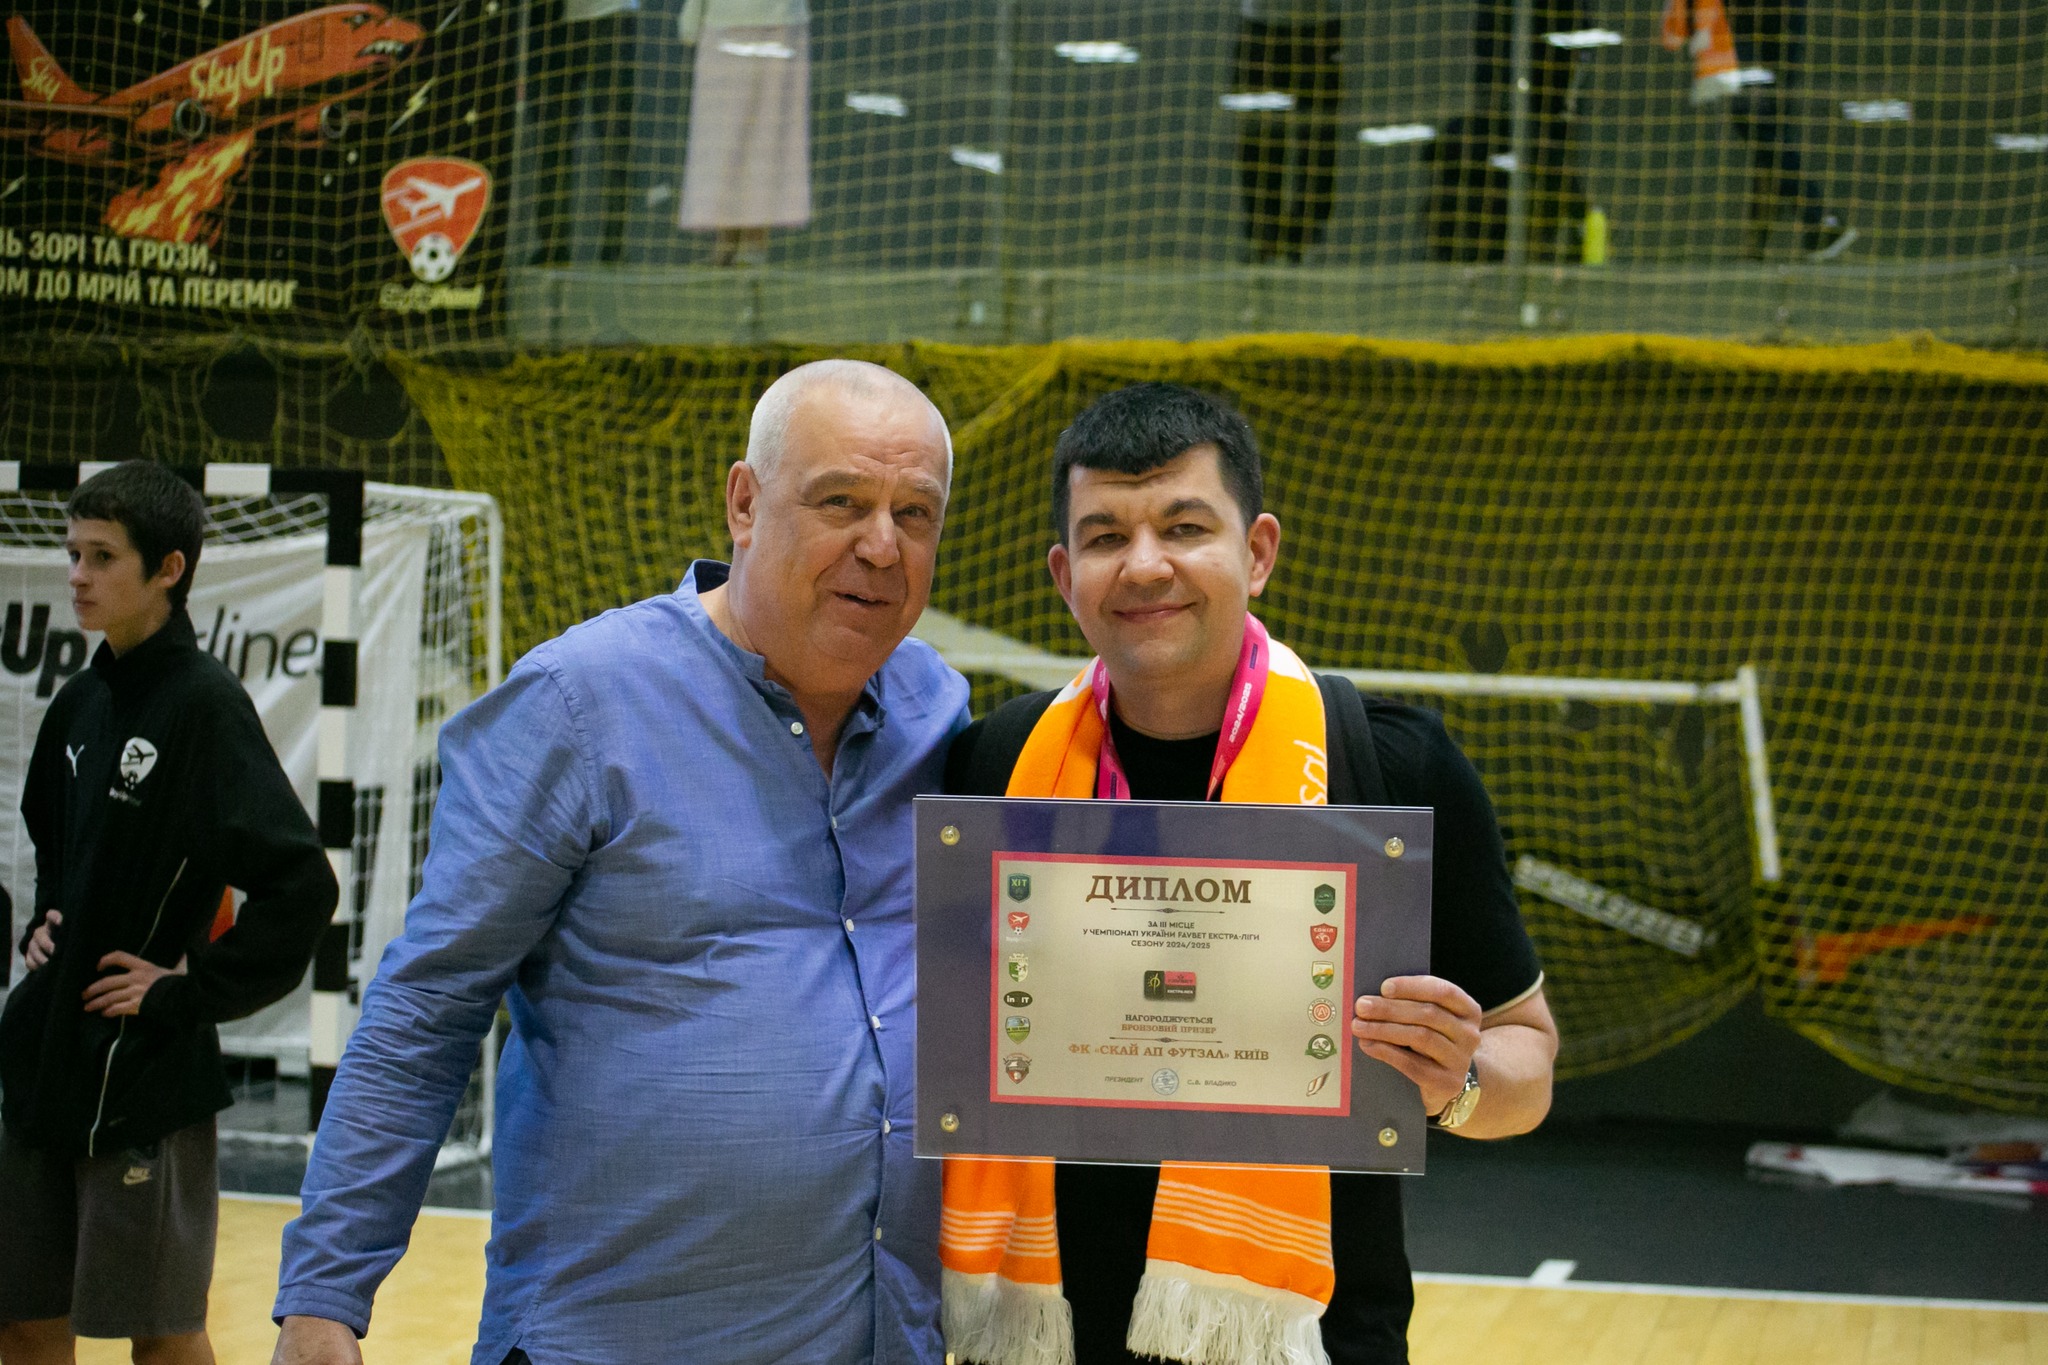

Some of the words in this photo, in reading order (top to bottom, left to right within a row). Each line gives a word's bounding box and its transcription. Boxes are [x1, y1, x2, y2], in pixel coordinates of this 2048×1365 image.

[189, 30, 287, 110] SkyUp
[29, 230, 87, 264] ЗОРІ
[91, 236, 122, 267] ТА
[128, 238, 217, 277] ГРОЗИ,
[34, 269, 72, 302] ДО
[76, 269, 142, 302] МРІЙ
[147, 276, 177, 306] ТА
[182, 277, 299, 309] ПЕРЕМОГ
[0, 602, 89, 699] Up
[1228, 682, 1253, 743] 2024/2025
[1085, 875, 1252, 904] ДИПЛОМ
[1147, 920, 1158, 928] ЗА
[1169, 921, 1195, 929] МІСЦЕ
[1082, 928, 1088, 936] У
[1089, 928, 1139, 937] ЧЕМПІОНАТІ
[1140, 929, 1176, 938] УКРАЇНИ
[1177, 931, 1207, 940] FAVBET
[1208, 933, 1260, 941] ЕКСТРА-ЛІГИ
[1131, 939, 1164, 948] СЕЗОНУ
[1166, 941, 1211, 949] 2024/2025
[1125, 1014, 1213, 1024] НАГОРОДЖУЄТЬСЯ
[1121, 1023, 1178, 1033] БРОНЗОВИЙ
[1180, 1025, 1217, 1034] ПРИЗЕР
[1068, 1043, 1091, 1054] ФК
[1143, 1047, 1163, 1057] АП
[1234, 1049, 1269, 1061] КИЇВ
[1104, 1076, 1144, 1084] ПРЕЗИДЕНТ
